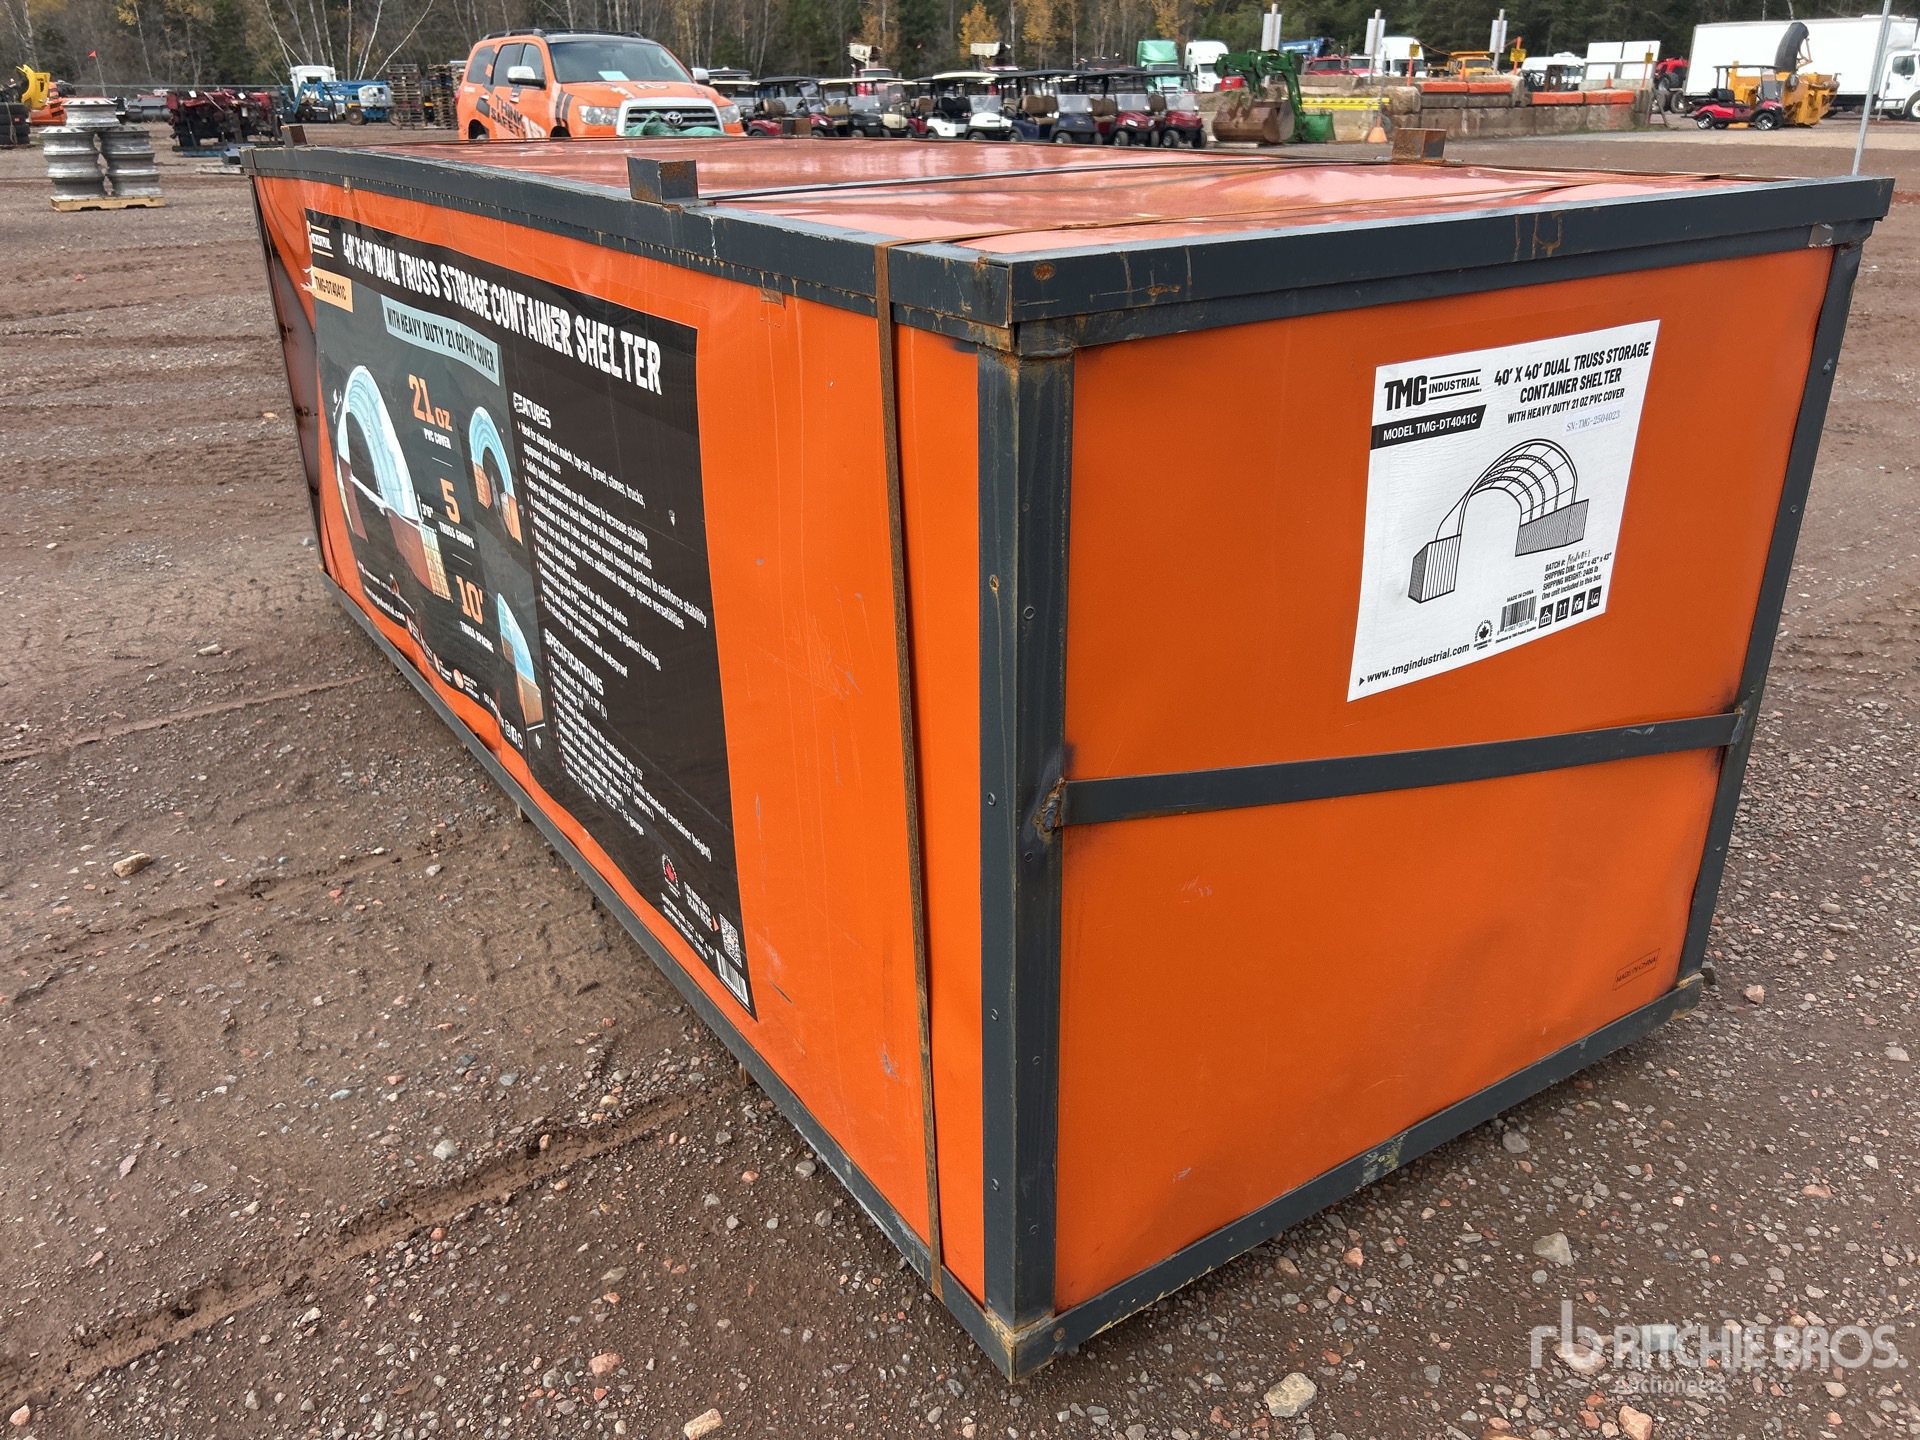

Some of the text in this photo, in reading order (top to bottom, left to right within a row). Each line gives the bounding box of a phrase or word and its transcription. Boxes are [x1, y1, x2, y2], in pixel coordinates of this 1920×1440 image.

[496, 94, 522, 125] THINK
[374, 244, 400, 286] DUAL
[400, 252, 440, 298] TRUSS
[440, 263, 492, 322] STORAGE
[490, 284, 573, 358] CONTAINER
[576, 315, 662, 396] SHELTER
[386, 306, 400, 330] WITH
[400, 313, 422, 338] HEAVY
[422, 322, 444, 346] DUTY
[446, 328, 456, 350] 21
[456, 332, 466, 353] OZ
[476, 342, 496, 373] COVER
[1494, 341, 1652, 386] 40' X 40' DUAL TRUSS STORAGE
[408, 374, 453, 432] 21 OZ
[1384, 375, 1428, 411] TMG
[1428, 376, 1480, 394] INDUSTRIAL
[1520, 367, 1622, 403] CONTAINER SHELTER
[513, 392, 552, 429] FEATURES
[1507, 388, 1625, 424] WITH HEAVY DUTY 21 OZ PVC COVER
[424, 428, 451, 450] PVC COVER
[1383, 413, 1478, 440] MODEL TMG-DT4041C
[440, 478, 460, 524] 5
[608, 476, 626, 496] stones,
[626, 485, 645, 507] trucks,
[438, 521, 456, 538] TRUSS
[571, 491, 577, 502] on
[600, 507, 605, 520] to
[605, 511, 626, 533] increase
[591, 523, 598, 534] on
[622, 543, 632, 556] and
[580, 533, 588, 545] and
[613, 554, 632, 575] tension
[632, 568, 651, 587] system
[651, 578, 657, 592] to
[658, 585, 682, 608] reinforce
[683, 601, 707, 623] stability
[1543, 577, 1564, 590] SHIPPING
[1564, 571, 1582, 582] WEIGHT:
[1544, 568, 1565, 581] SHIPPING
[1545, 560, 1560, 572] BATCH
[456, 575, 484, 624] 10'
[616, 576, 635, 596] storage
[636, 589, 652, 606] space
[1506, 594, 1517, 602] MADE
[1522, 589, 1534, 598] CHINA
[1551, 588, 1560, 596] unit
[1560, 580, 1579, 593] included
[544, 628, 604, 696] SPECIFICATIONS
[1367, 644, 1470, 682] www.tmgindustrial.com
